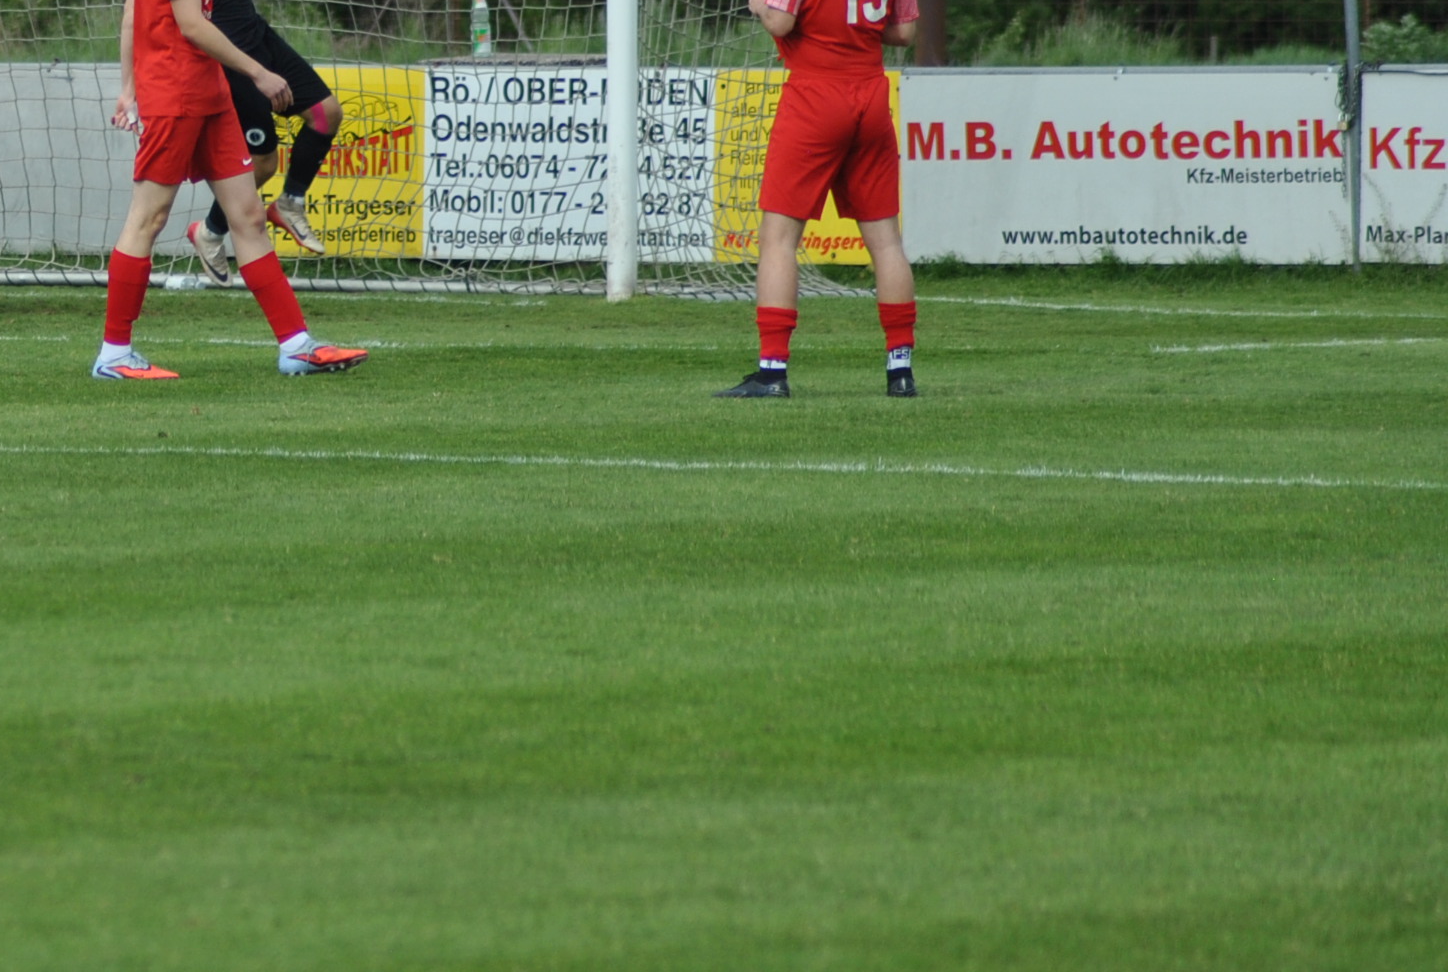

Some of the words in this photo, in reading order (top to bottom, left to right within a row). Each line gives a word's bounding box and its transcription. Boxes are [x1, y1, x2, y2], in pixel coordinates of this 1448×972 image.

[503, 77, 708, 106] OBER-DEN
[675, 117, 707, 144] 45
[907, 121, 1012, 161] M.B.
[1030, 119, 1344, 160] Autotechnik
[1369, 126, 1446, 170] Kfz
[1186, 168, 1344, 184] Kfz-Meisterbetrieb
[323, 194, 416, 221] Trageser
[429, 188, 503, 214] Mobil:
[511, 191, 568, 215] 0177
[1002, 225, 1248, 245] www.mbautotechnik.de
[1365, 225, 1448, 245] Max-Pla
